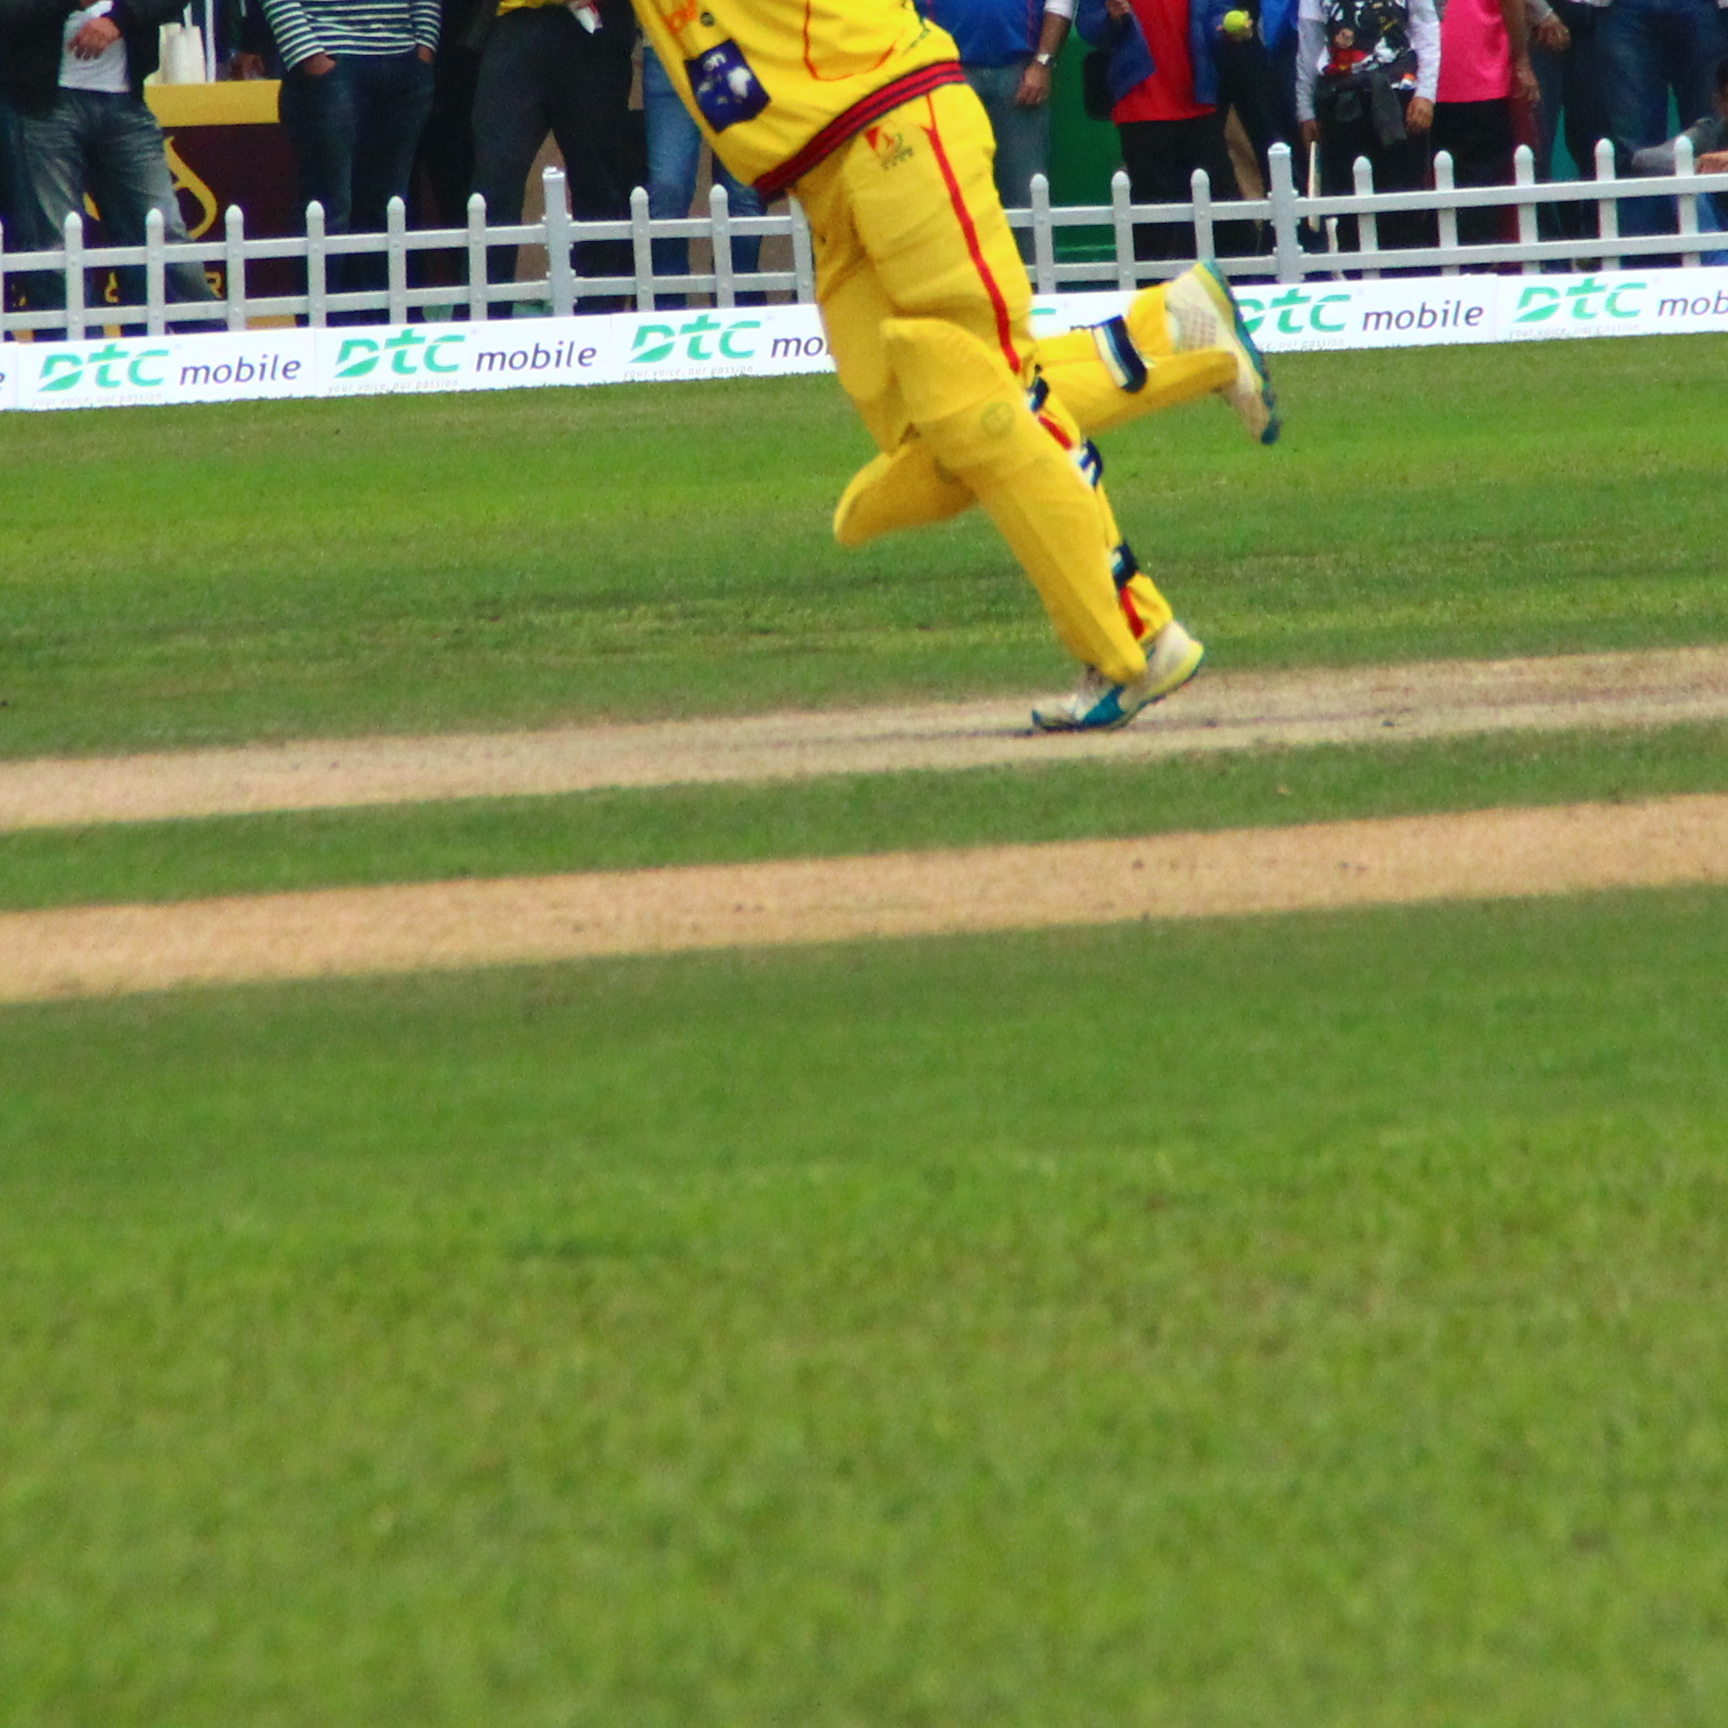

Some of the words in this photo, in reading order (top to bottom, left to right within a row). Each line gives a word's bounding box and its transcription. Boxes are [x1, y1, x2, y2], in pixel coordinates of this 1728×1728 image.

[1361, 298, 1485, 332] mobile
[178, 353, 303, 386] mobile
[475, 339, 598, 373] mobile
